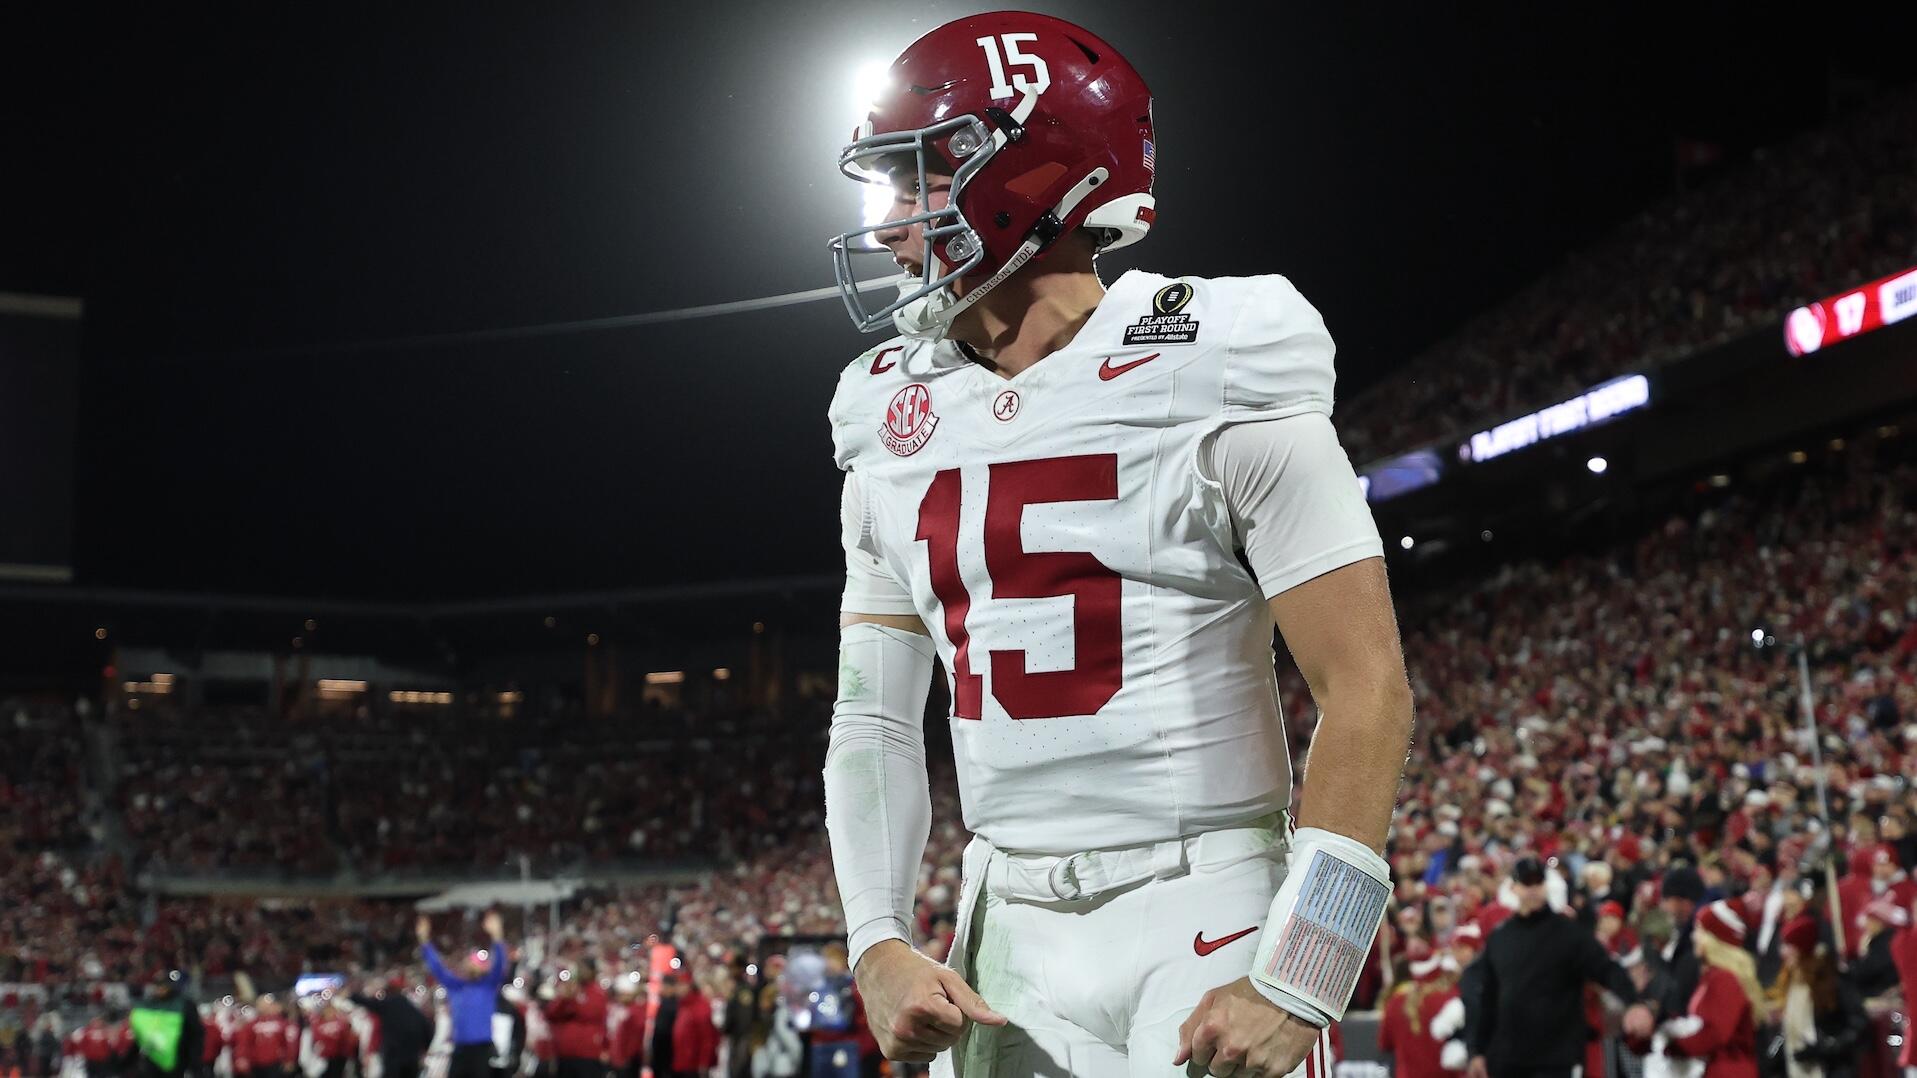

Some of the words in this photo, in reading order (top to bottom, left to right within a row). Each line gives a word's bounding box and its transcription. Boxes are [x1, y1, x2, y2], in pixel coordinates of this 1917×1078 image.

[976, 33, 1051, 100] 15
[966, 268, 1011, 303] CRIMSON
[1011, 246, 1034, 268] TIDE
[1127, 325, 1159, 335] FIRST
[1160, 323, 1197, 333] ROUND
[1140, 315, 1188, 325] PLAYOFF
[870, 346, 904, 375] C
[890, 385, 927, 436] SEC
[997, 395, 1015, 416] A
[885, 429, 929, 455] GRADUATE
[915, 453, 1122, 720] 15
